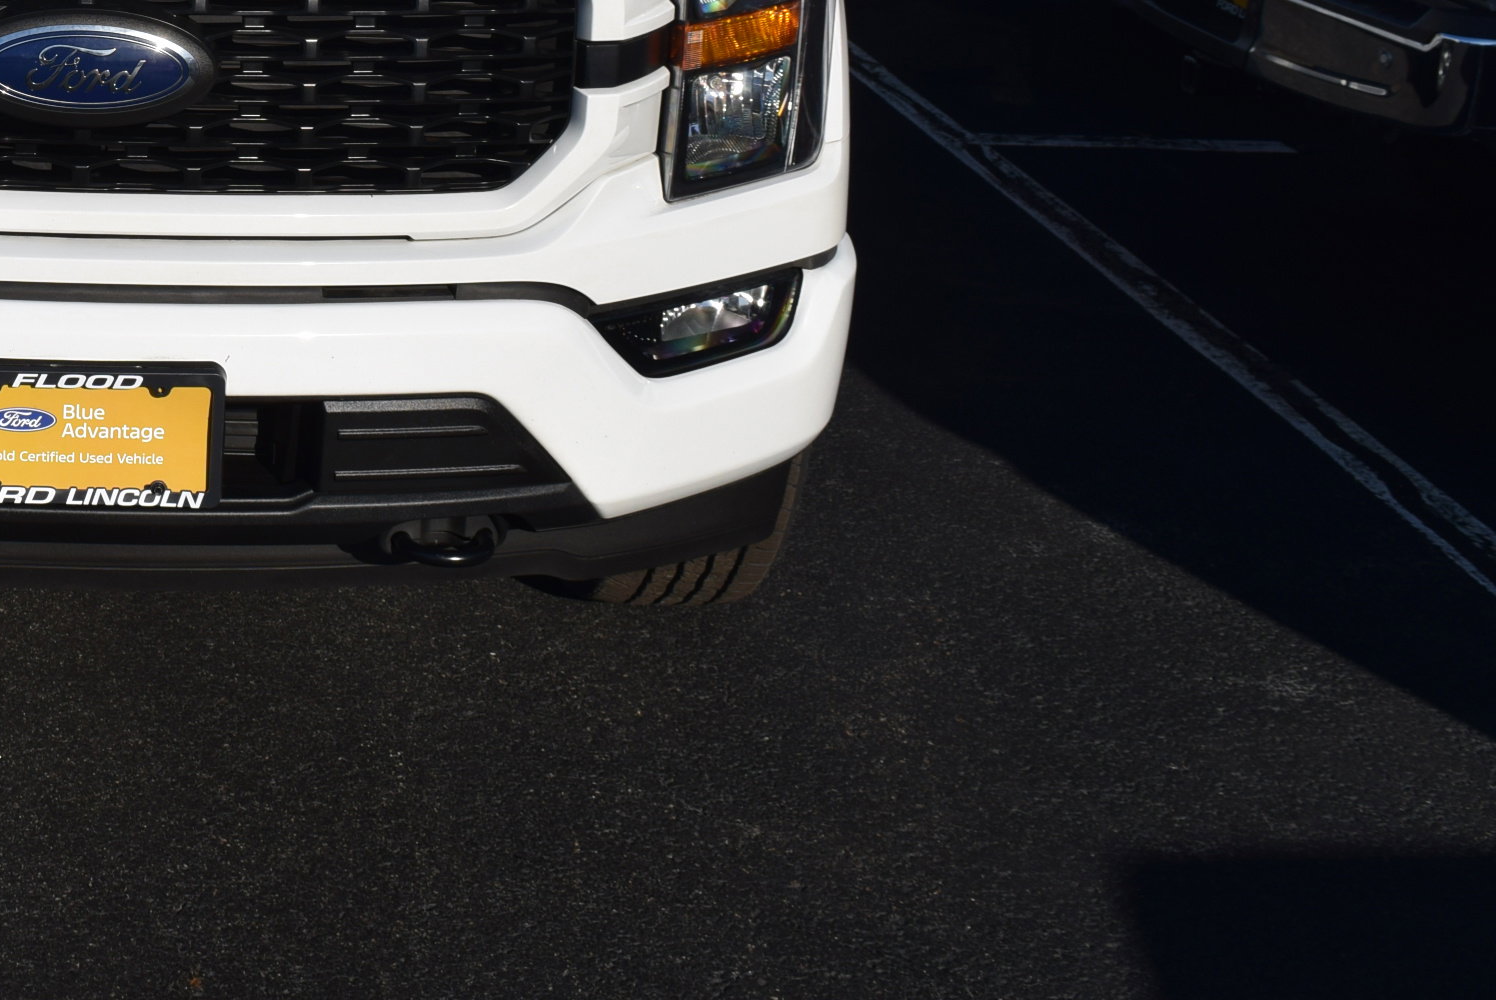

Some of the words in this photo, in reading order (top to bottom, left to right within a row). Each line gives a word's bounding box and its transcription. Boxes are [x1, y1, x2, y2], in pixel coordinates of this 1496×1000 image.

[24, 43, 149, 95] Ford
[11, 373, 144, 390] FLOOD
[0, 409, 42, 429] Ford
[62, 404, 106, 421] Blue
[61, 422, 165, 443] Advantage
[19, 450, 75, 464] Certified
[79, 452, 113, 464] Used
[117, 452, 164, 465] Vehicle
[65, 487, 205, 509] LINCOLN
